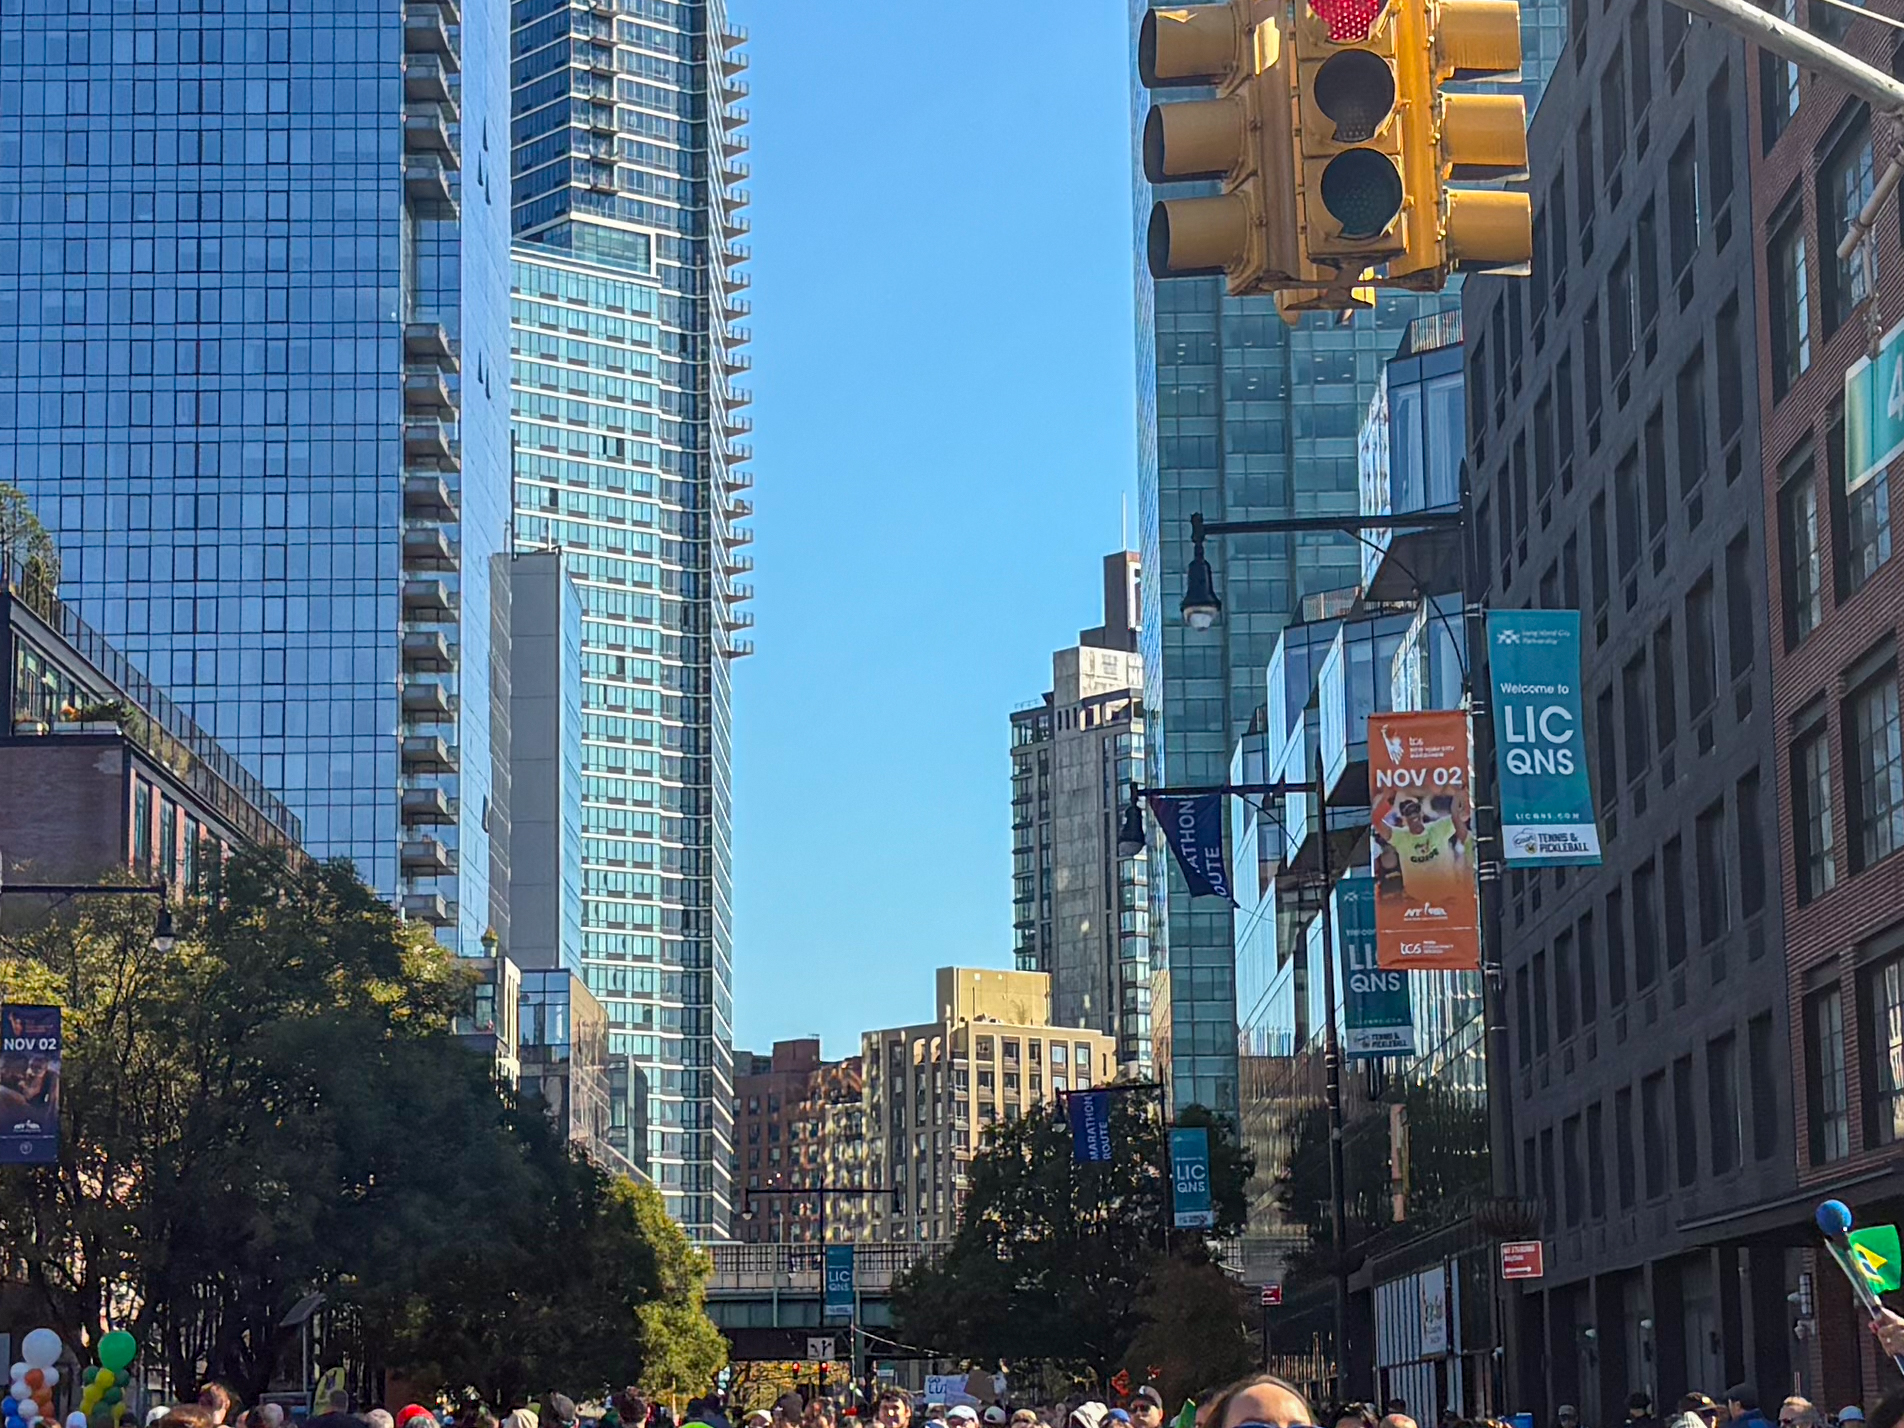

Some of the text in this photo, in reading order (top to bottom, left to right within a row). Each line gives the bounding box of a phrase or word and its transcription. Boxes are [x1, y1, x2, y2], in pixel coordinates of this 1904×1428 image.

[1500, 682, 1570, 695] Welcome to
[1504, 705, 1574, 744] LIC
[1506, 748, 1575, 775] QNS
[1376, 767, 1463, 788] NOV 02
[1178, 800, 1200, 869] ATHON
[1205, 846, 1228, 897] OUTE
[1348, 943, 1378, 971] LI
[1350, 974, 1401, 993] QNS
[3, 1037, 57, 1051] NOV 02
[1083, 1096, 1099, 1161] MARATHON
[1098, 1121, 1112, 1160] ROUTE
[1176, 1164, 1206, 1181] LIC
[1176, 1181, 1205, 1193] QNS
[828, 1271, 851, 1283] LIC
